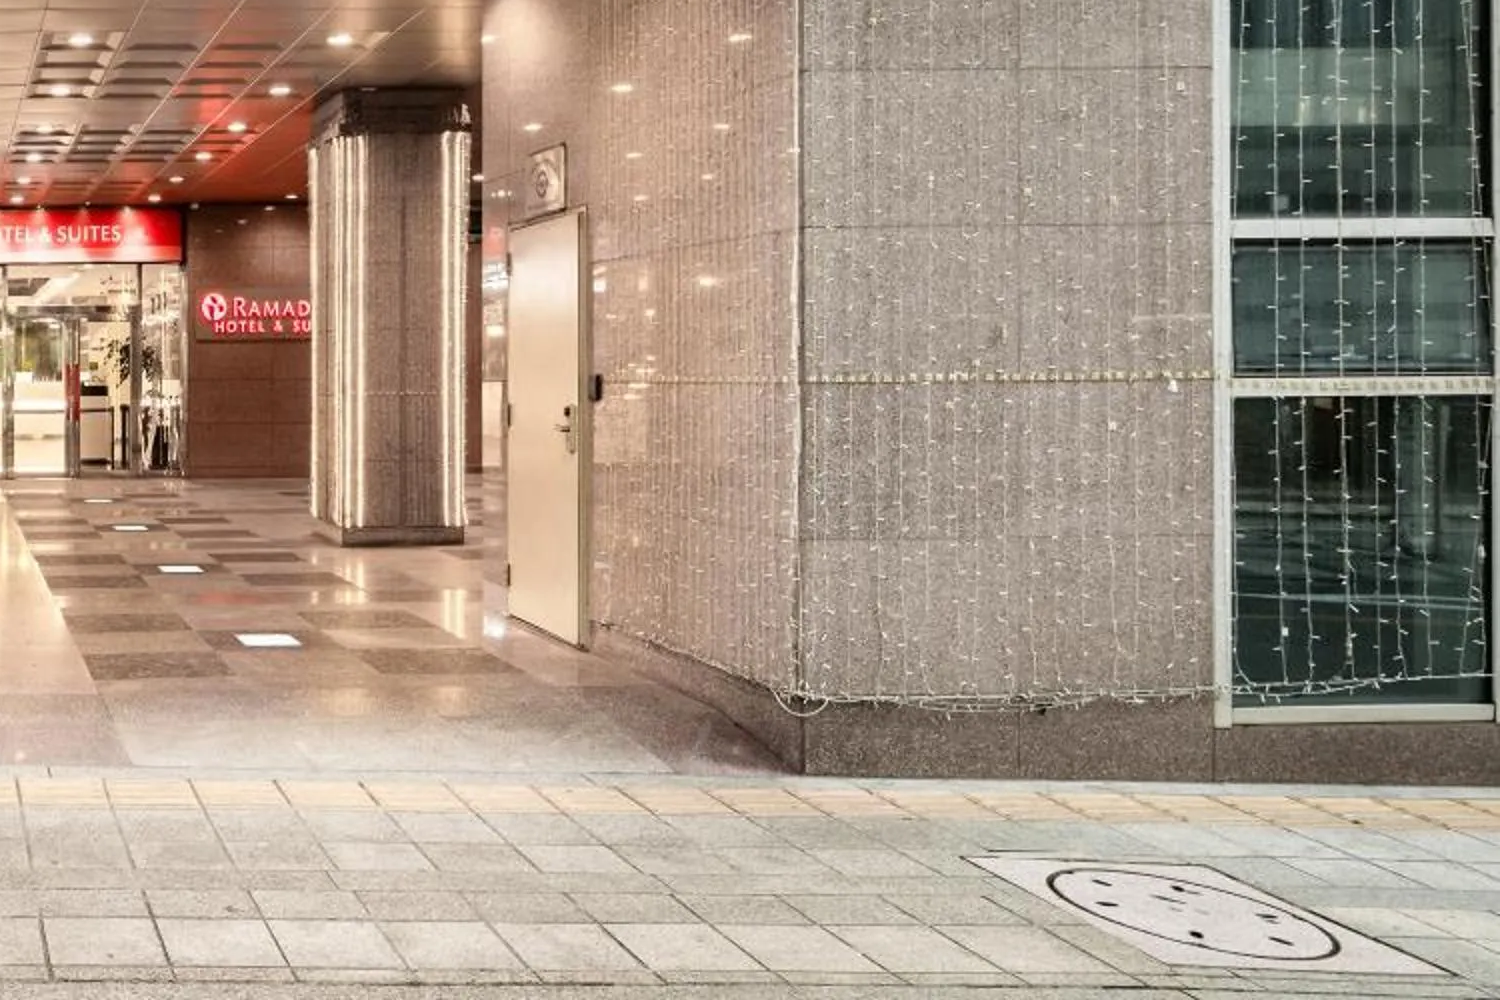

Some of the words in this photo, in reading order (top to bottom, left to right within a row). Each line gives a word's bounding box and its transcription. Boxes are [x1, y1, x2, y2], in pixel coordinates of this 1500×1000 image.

[38, 227, 50, 242] &
[57, 225, 122, 242] SUITES
[215, 320, 265, 333] HOTEL
[273, 320, 283, 333] &
